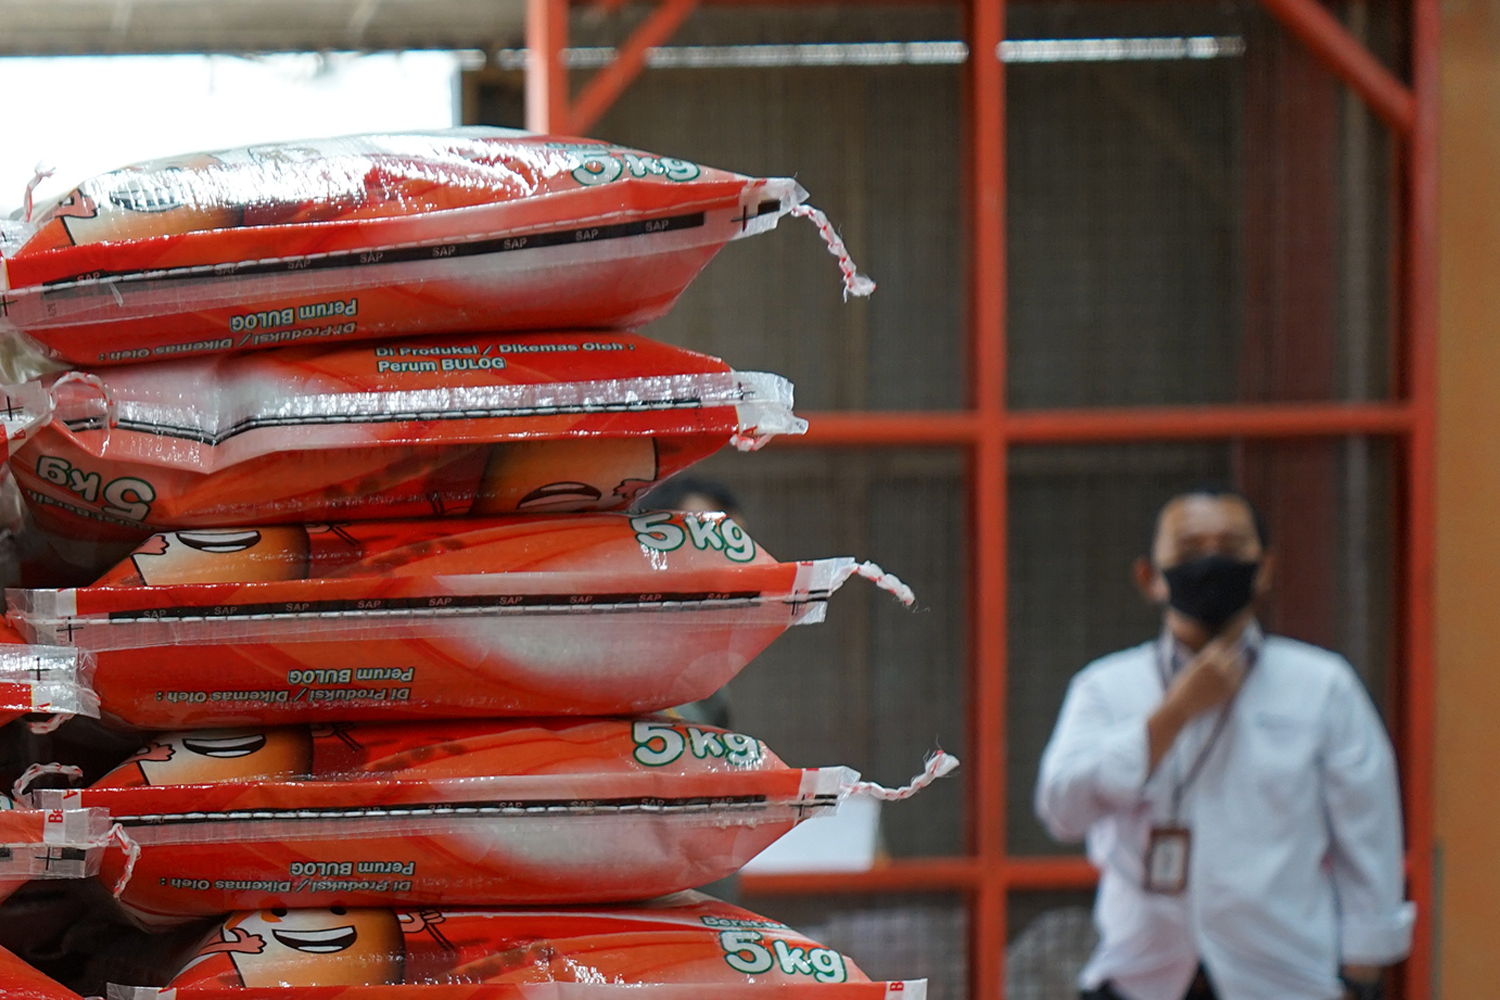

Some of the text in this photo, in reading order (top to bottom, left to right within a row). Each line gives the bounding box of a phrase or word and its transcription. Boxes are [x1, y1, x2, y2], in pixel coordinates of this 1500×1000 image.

[229, 299, 358, 331] Perum BULOG
[377, 356, 506, 373] Perum BULOG
[630, 512, 756, 562] 5kg
[288, 667, 415, 685] Perum BULOG
[167, 690, 208, 702] Oleh
[212, 689, 288, 702] Dikemas
[308, 687, 387, 700] Produksi
[391, 687, 410, 699] Di
[631, 720, 762, 766] 5kg
[290, 861, 415, 876] Perum BULOG
[719, 929, 848, 984] 5kg
